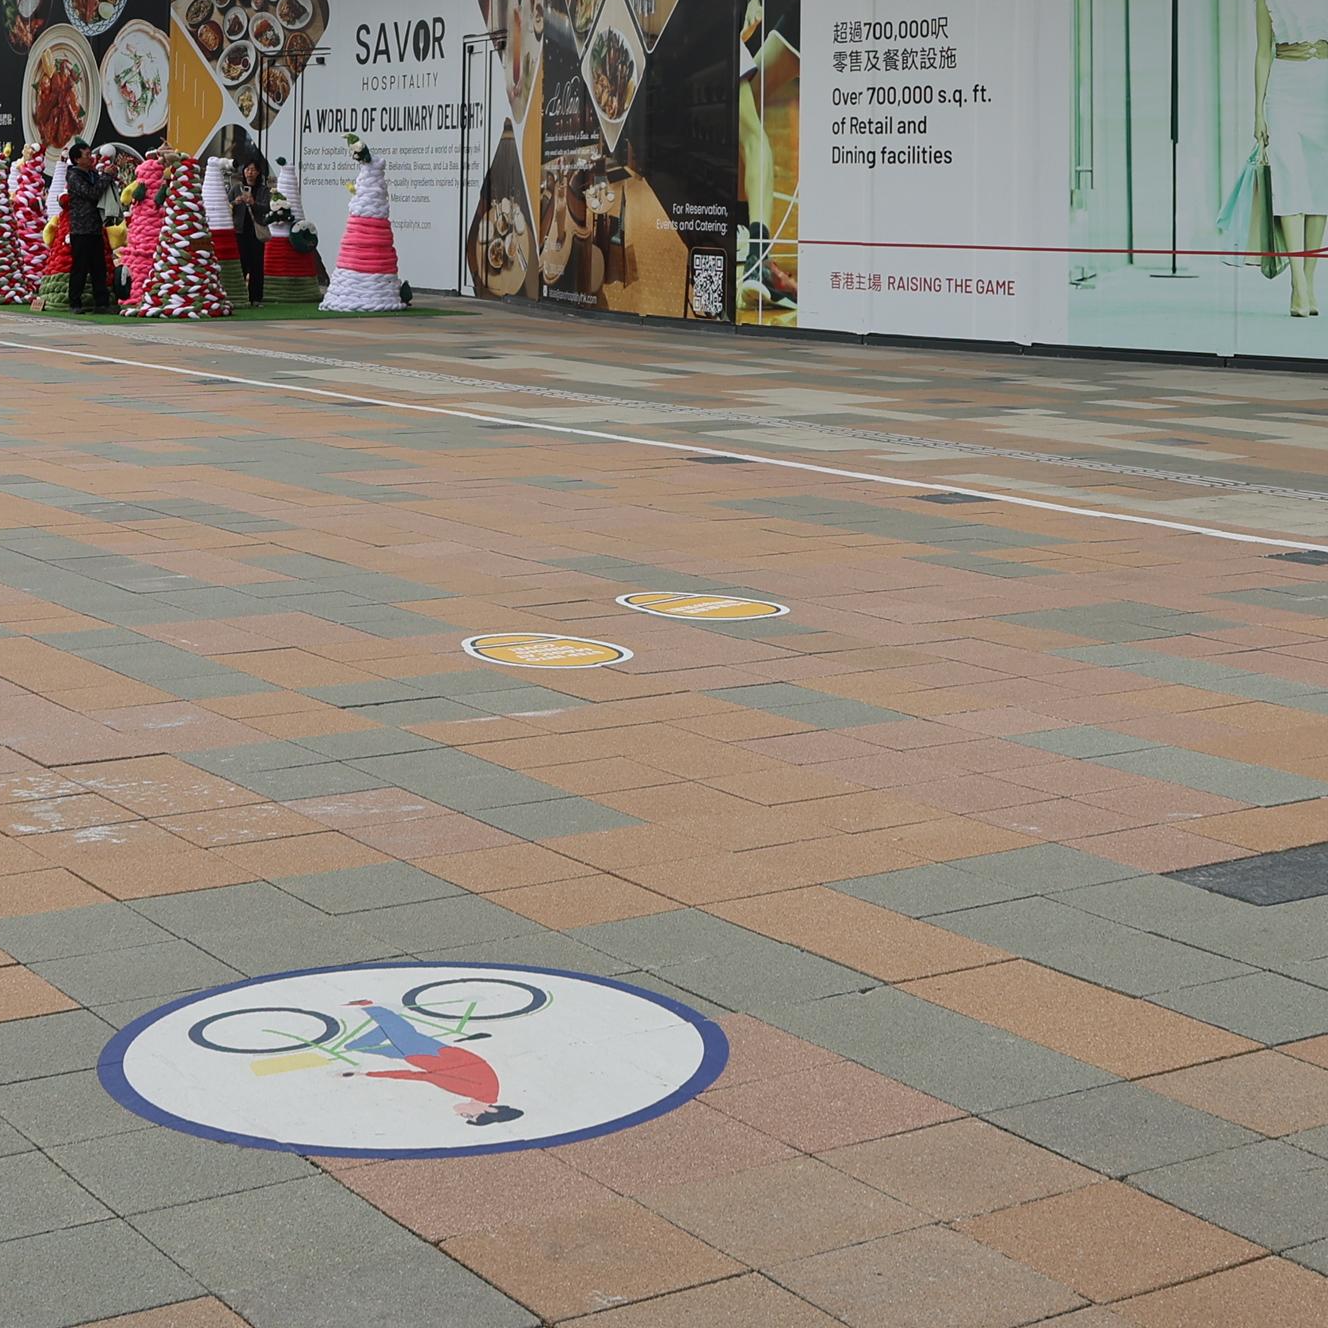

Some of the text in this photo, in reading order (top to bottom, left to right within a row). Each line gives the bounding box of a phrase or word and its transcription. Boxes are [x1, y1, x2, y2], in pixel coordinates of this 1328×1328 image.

[356, 16, 446, 65] SAVOR
[833, 16, 949, 44] 超過700,000呎
[833, 46, 957, 73] 零售及餐飲設施
[362, 72, 439, 91] HOSPITALITY
[832, 84, 992, 108] Over 700,000 s.q. ft.
[303, 109, 312, 133] A
[317, 108, 357, 133] WORLD
[362, 107, 377, 132] OF
[380, 104, 434, 132] CULINARY
[832, 116, 927, 135] of Retail and
[303, 146, 320, 155] Savor
[832, 145, 952, 169] Dining facilities
[673, 203, 728, 217] For Reservation,
[656, 218, 728, 236] Events and Catering:
[830, 272, 1016, 296] 香港主場 RAISING THE GAME
